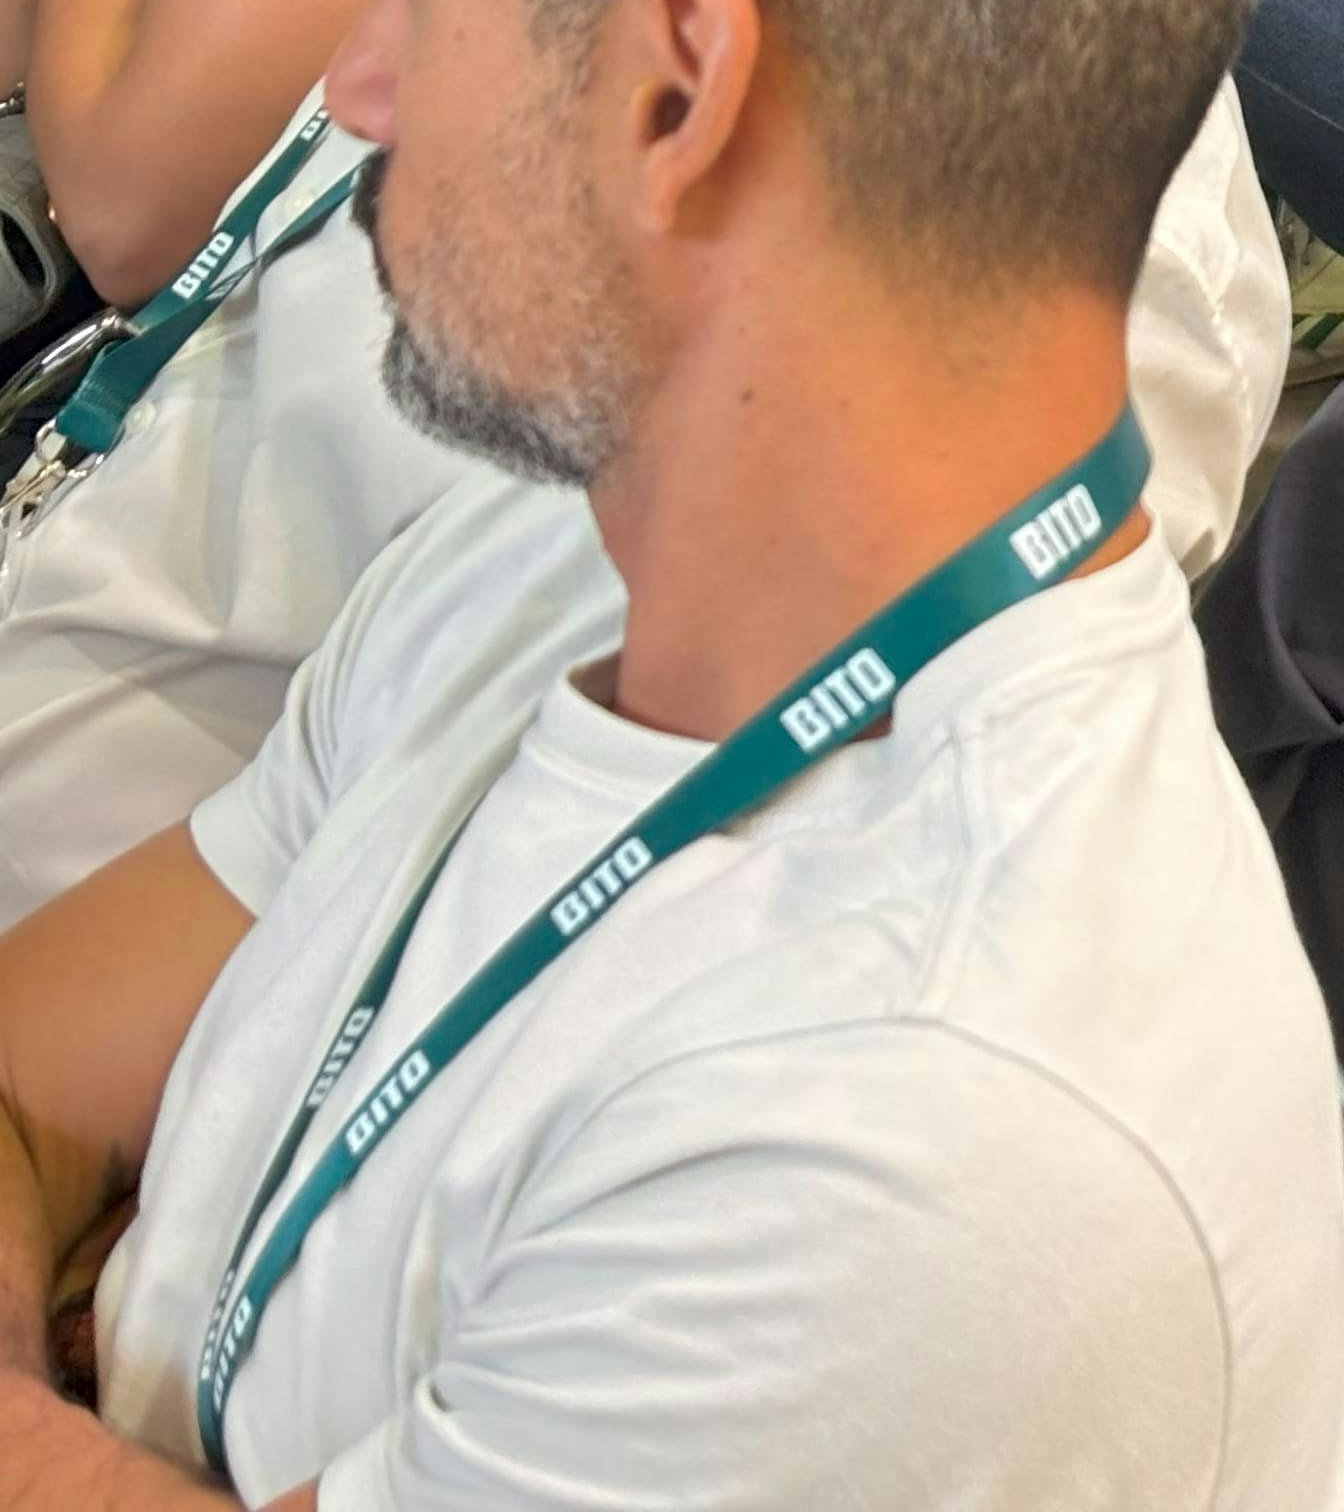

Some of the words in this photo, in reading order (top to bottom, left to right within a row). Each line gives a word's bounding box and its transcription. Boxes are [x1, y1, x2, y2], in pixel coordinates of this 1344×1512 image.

[171, 231, 235, 299] BITO
[1009, 482, 1102, 581] BITO
[780, 647, 897, 754] BITO
[550, 836, 653, 936] BITO
[305, 1005, 375, 1109] BITO
[343, 1048, 431, 1157] BITO
[213, 1294, 252, 1415] BITO
